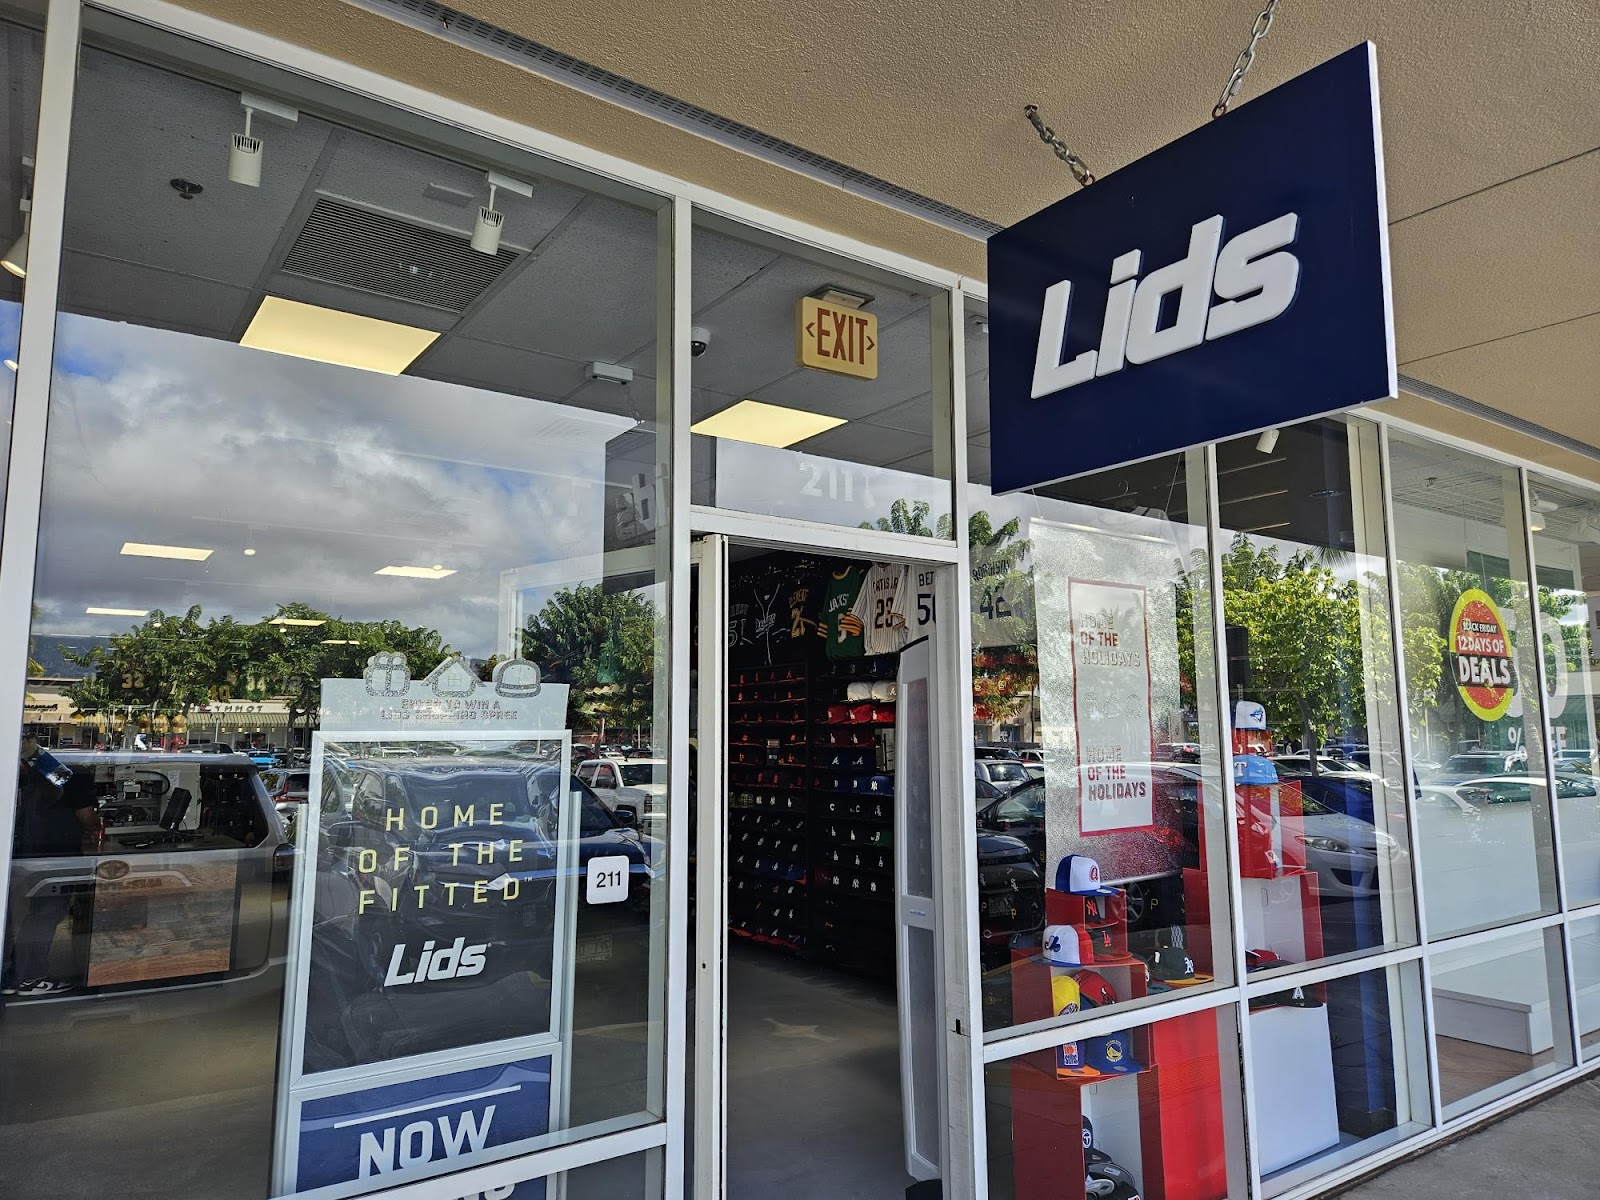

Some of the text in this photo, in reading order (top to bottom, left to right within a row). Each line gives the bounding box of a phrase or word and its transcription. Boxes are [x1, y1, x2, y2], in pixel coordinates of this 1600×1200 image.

[1030, 211, 1301, 399] Lids
[817, 307, 868, 365] EXIT
[799, 460, 854, 502] 211
[874, 596, 894, 629] 23
[1080, 631, 1119, 648] OF THE
[1468, 636, 1492, 653] DAYS
[1492, 638, 1505, 654] OF
[1082, 651, 1141, 668] HOLIDAYS
[1458, 655, 1511, 685] DEALS
[121, 673, 144, 689] 32
[464, 699, 489, 710] WIN
[493, 699, 501, 710] A
[481, 710, 518, 720] SPREE
[1086, 746, 1122, 763] HOME
[1087, 764, 1126, 781] OF THE
[1088, 781, 1146, 802] HOLIDAYS
[385, 802, 504, 832] HOME
[358, 839, 523, 874] OF THE
[596, 869, 622, 889] 211
[383, 936, 488, 988] Lids
[358, 1104, 497, 1181] NOW
